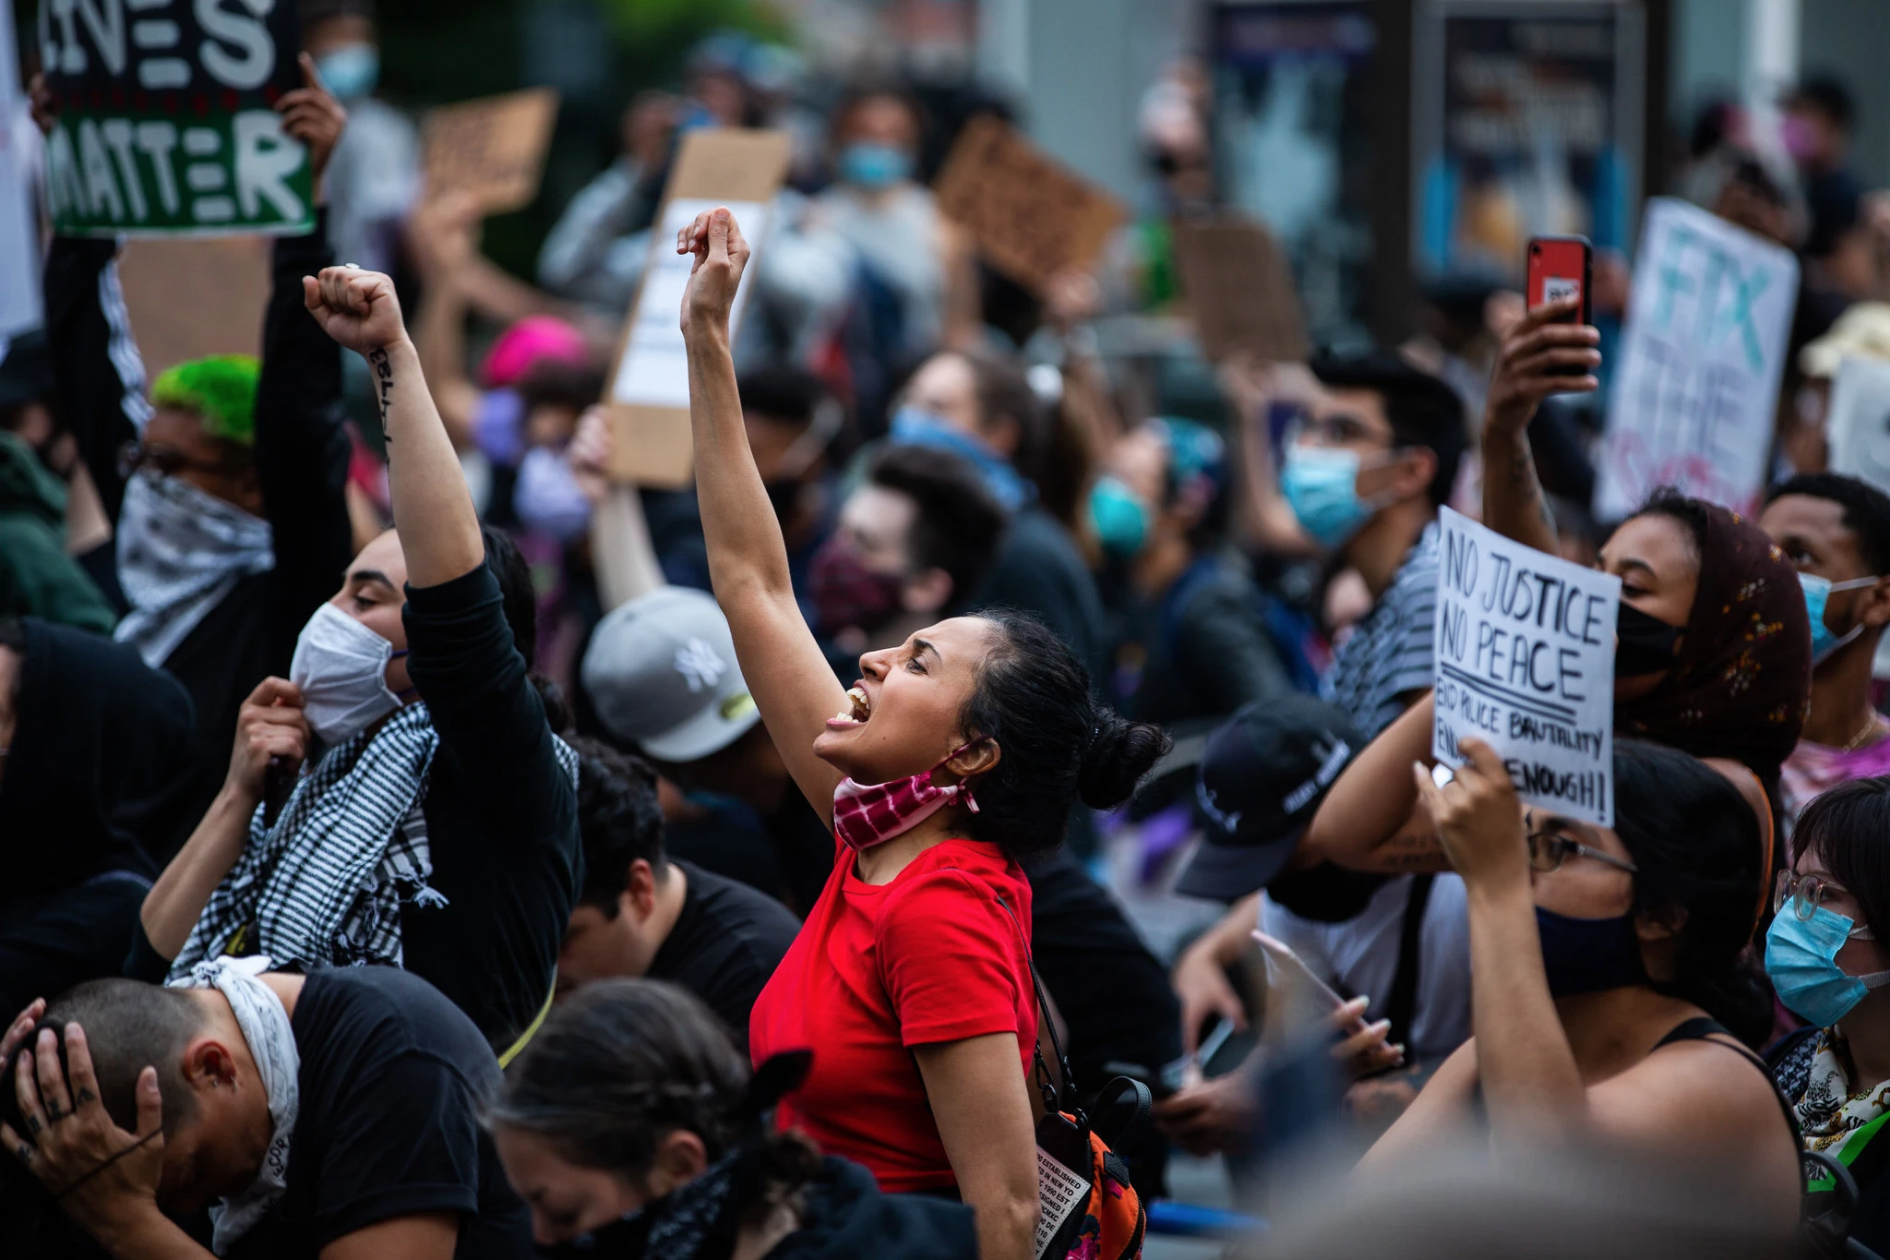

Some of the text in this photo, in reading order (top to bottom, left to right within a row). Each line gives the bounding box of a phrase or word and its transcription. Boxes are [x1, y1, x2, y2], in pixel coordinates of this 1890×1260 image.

[48, 109, 306, 224] MATTER
[1657, 220, 1772, 377] FIX
[1447, 528, 1606, 645] NO JUSTICE
[1440, 597, 1586, 703] NO PEACE
[1436, 677, 1604, 761] END POLICE BRUTALITY
[1504, 757, 1606, 822] ENOUGH!
[1042, 1158, 1081, 1190] ESTABLISHED
[1044, 1172, 1051, 1180] IN
[1050, 1176, 1064, 1190] NEW
[1063, 1186, 1075, 1196] YO
[1056, 1193, 1070, 1205] EST
[1045, 1221, 1056, 1232] DE
